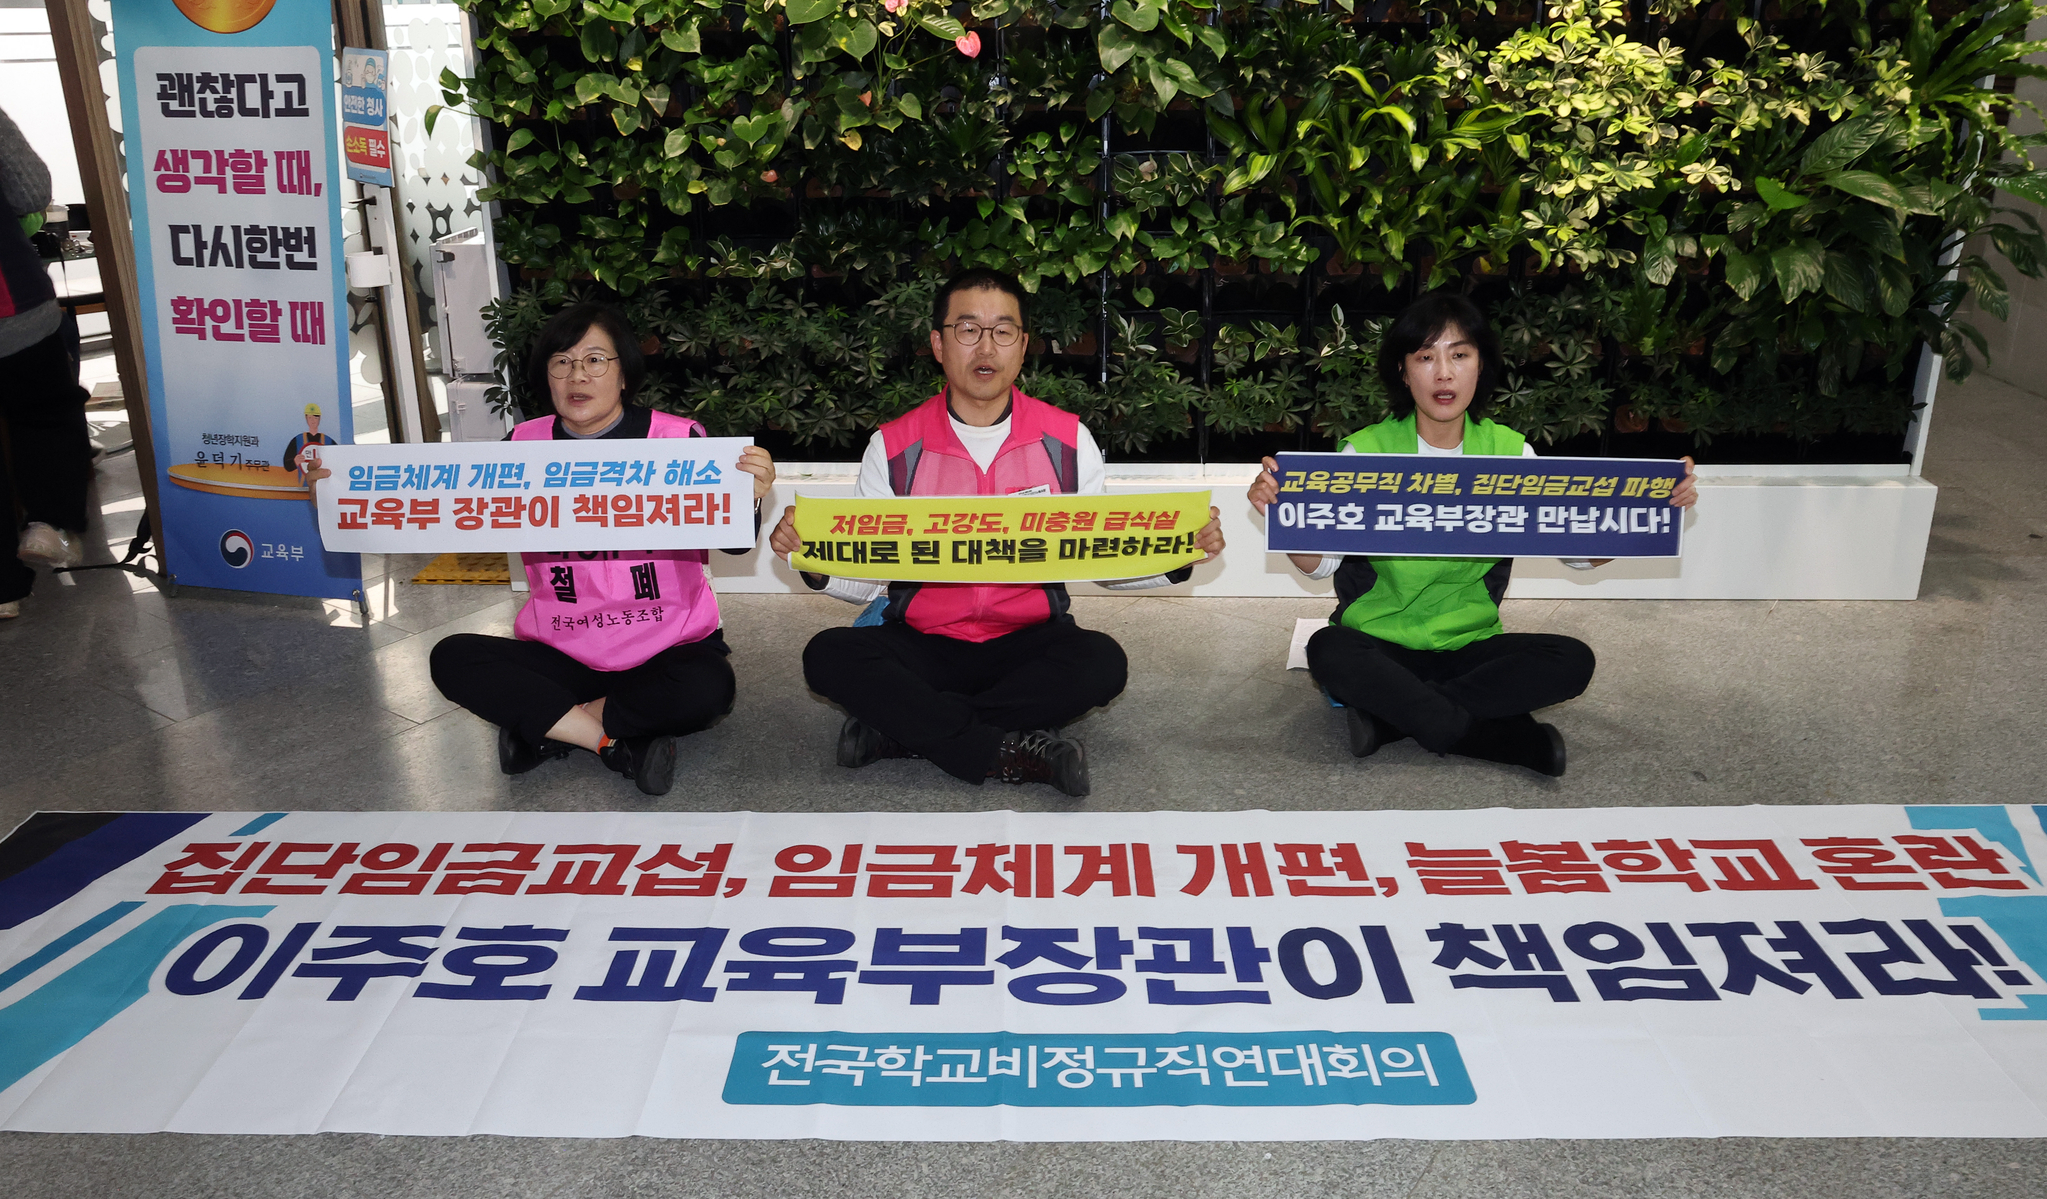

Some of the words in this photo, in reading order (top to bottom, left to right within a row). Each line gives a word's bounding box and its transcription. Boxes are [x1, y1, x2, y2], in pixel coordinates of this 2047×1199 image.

[156, 72, 309, 118] 괜찮다고
[346, 136, 367, 155] 손소독
[369, 139, 385, 158] 필수
[154, 149, 267, 194] 생각할
[275, 151, 321, 196] 때,
[168, 225, 317, 270] 다시한번
[172, 296, 282, 342] 확인할
[289, 302, 325, 344] 때
[202, 433, 259, 447] 청년장학지원과
[245, 460, 269, 472] 주무관
[349, 464, 460, 491] 임금체계
[468, 463, 530, 489] 개편,
[544, 460, 656, 487] 임금격차
[664, 460, 721, 486] 해소
[1280, 471, 1401, 493] 교육공무직
[1407, 473, 1461, 495] 차별,
[1472, 475, 1618, 496] 집단임금교섭
[1621, 477, 1674, 499] 파행
[339, 498, 440, 529] 교육부
[453, 496, 559, 530] 장관이
[573, 493, 730, 527] 책임져라!
[831, 515, 913, 535] 저임금,
[924, 513, 1009, 534] 고강도,
[1021, 512, 1097, 532] 미충원
[1104, 511, 1180, 530] 급식실
[1279, 503, 1365, 530] 이주호
[1375, 504, 1528, 533] 교육부장관
[1538, 507, 1670, 533] 만납시다!
[262, 544, 304, 561] 교육부
[802, 541, 899, 563] 제대로
[911, 541, 939, 564] 된
[952, 539, 1048, 564] 대책을
[1059, 532, 1194, 559] 마련하라!
[550, 566, 577, 603] 철
[630, 562, 660, 600] 폐
[552, 606, 663, 630] 전국여성노동조합
[147, 842, 746, 898] 집단임금교섭,
[769, 843, 1155, 898] 임금체계
[1177, 842, 1398, 897] 개편,
[1406, 839, 1820, 895] 늘봄학교
[1800, 835, 2027, 890] 혼란
[166, 922, 570, 1001] 이주호
[574, 926, 1414, 1005] 교육부장관이
[1426, 919, 2031, 1002] 책임져라!
[762, 1044, 1439, 1088] 전국학교비정규직연대회의
